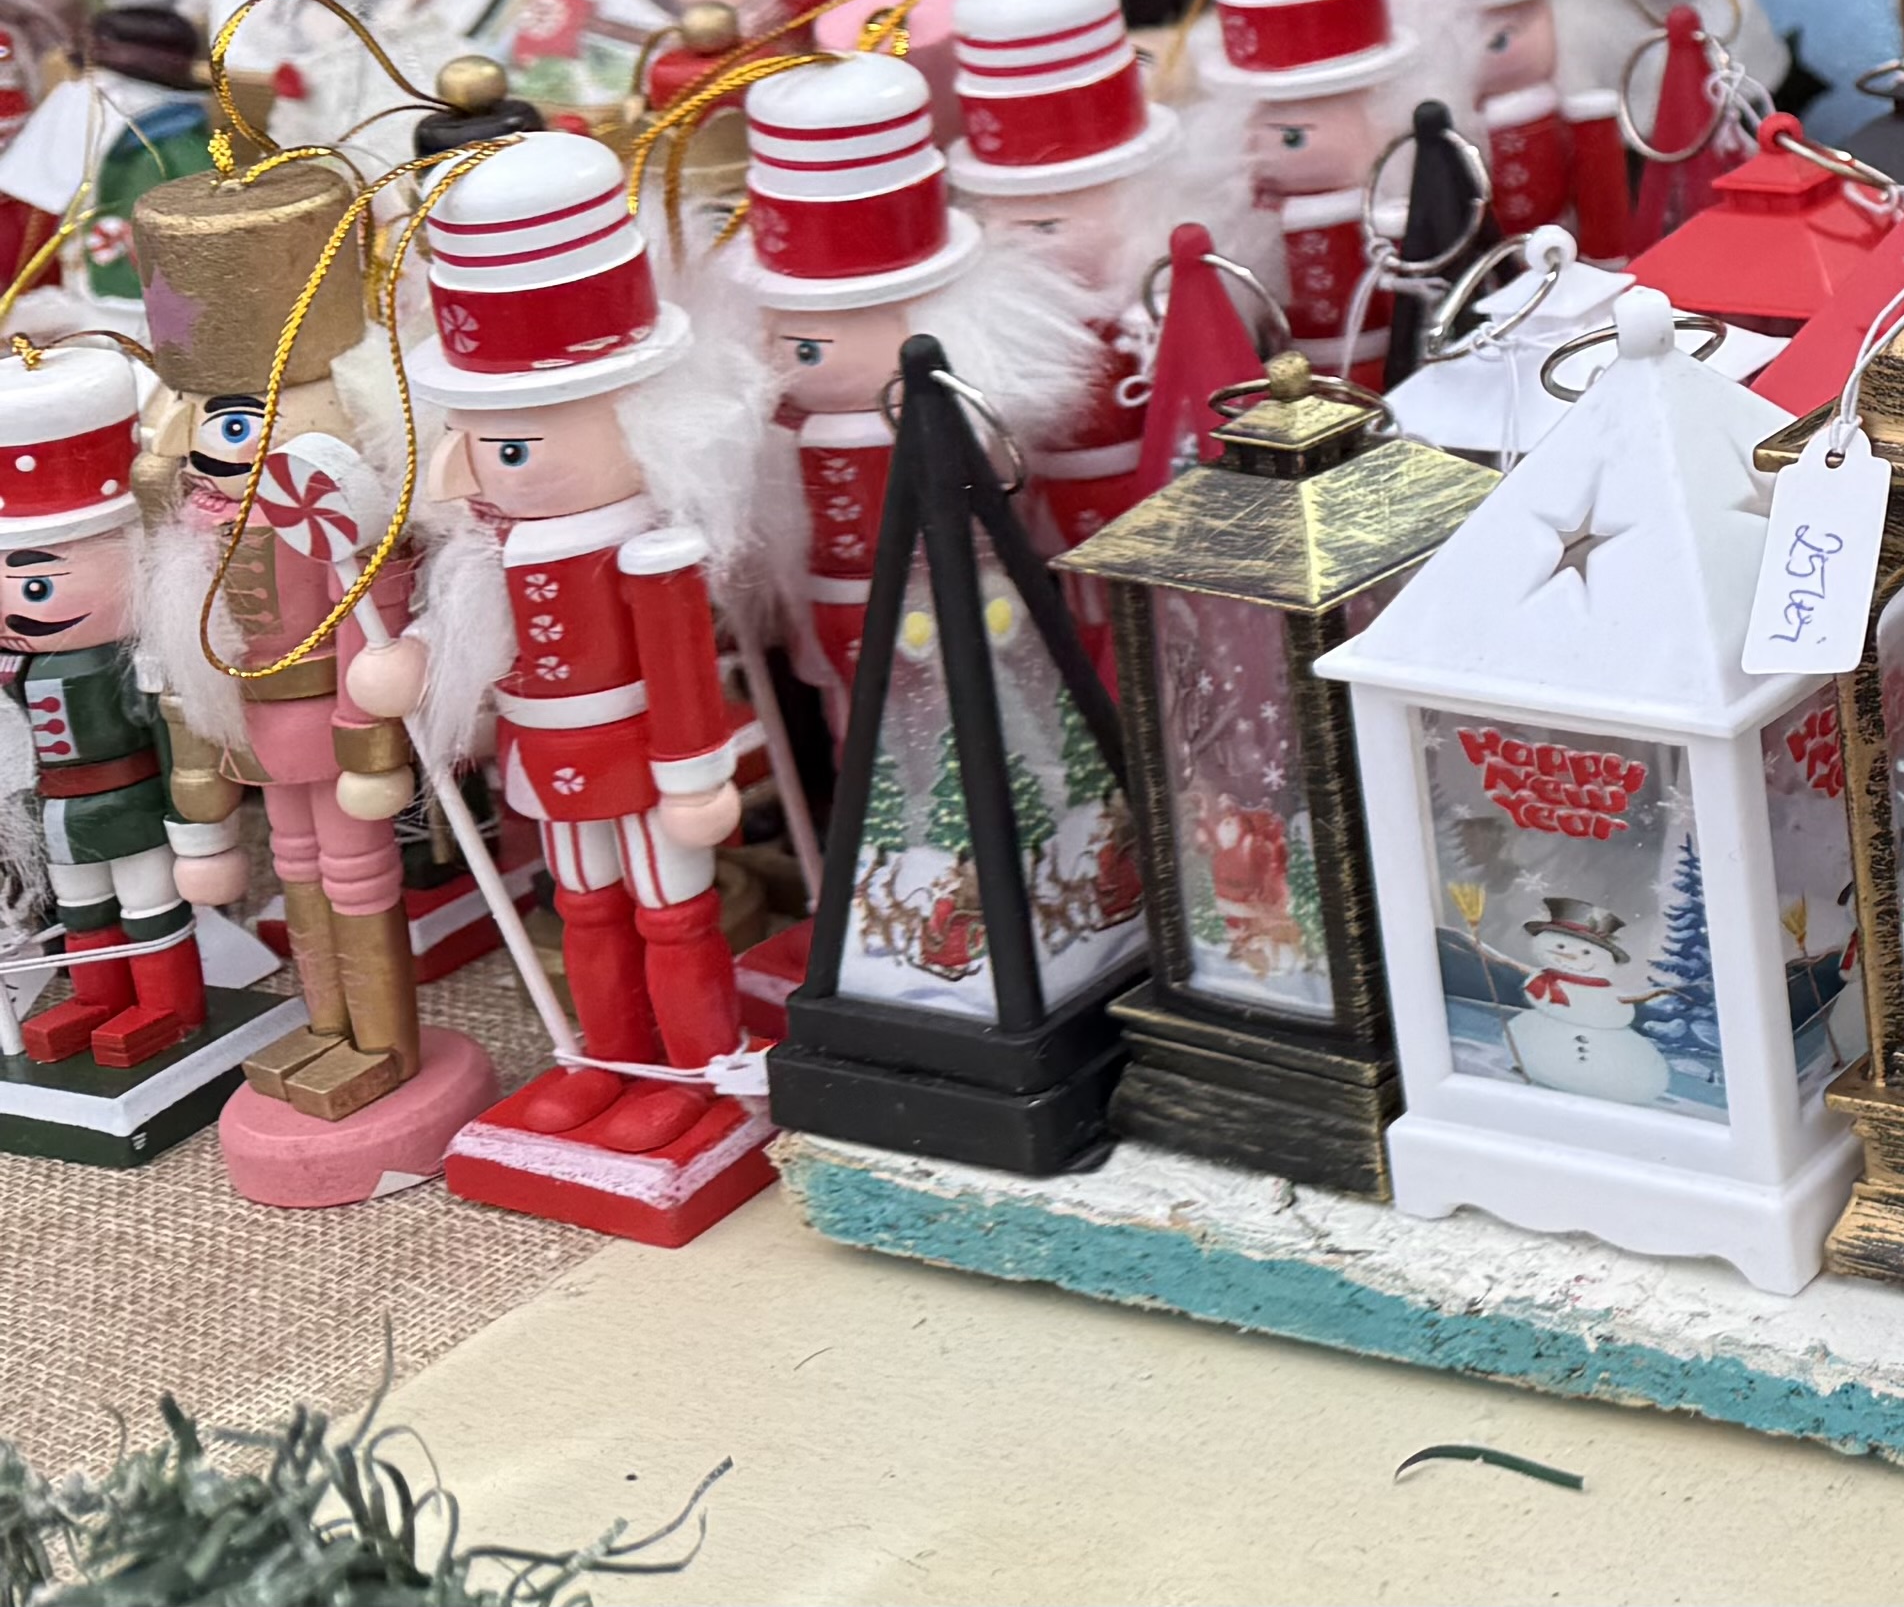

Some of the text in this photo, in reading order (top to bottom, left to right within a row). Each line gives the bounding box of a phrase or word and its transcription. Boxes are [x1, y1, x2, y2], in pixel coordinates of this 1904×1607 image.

[1457, 726, 1648, 794] Happy
[1484, 756, 1628, 815] New
[1486, 790, 1630, 841] Year
